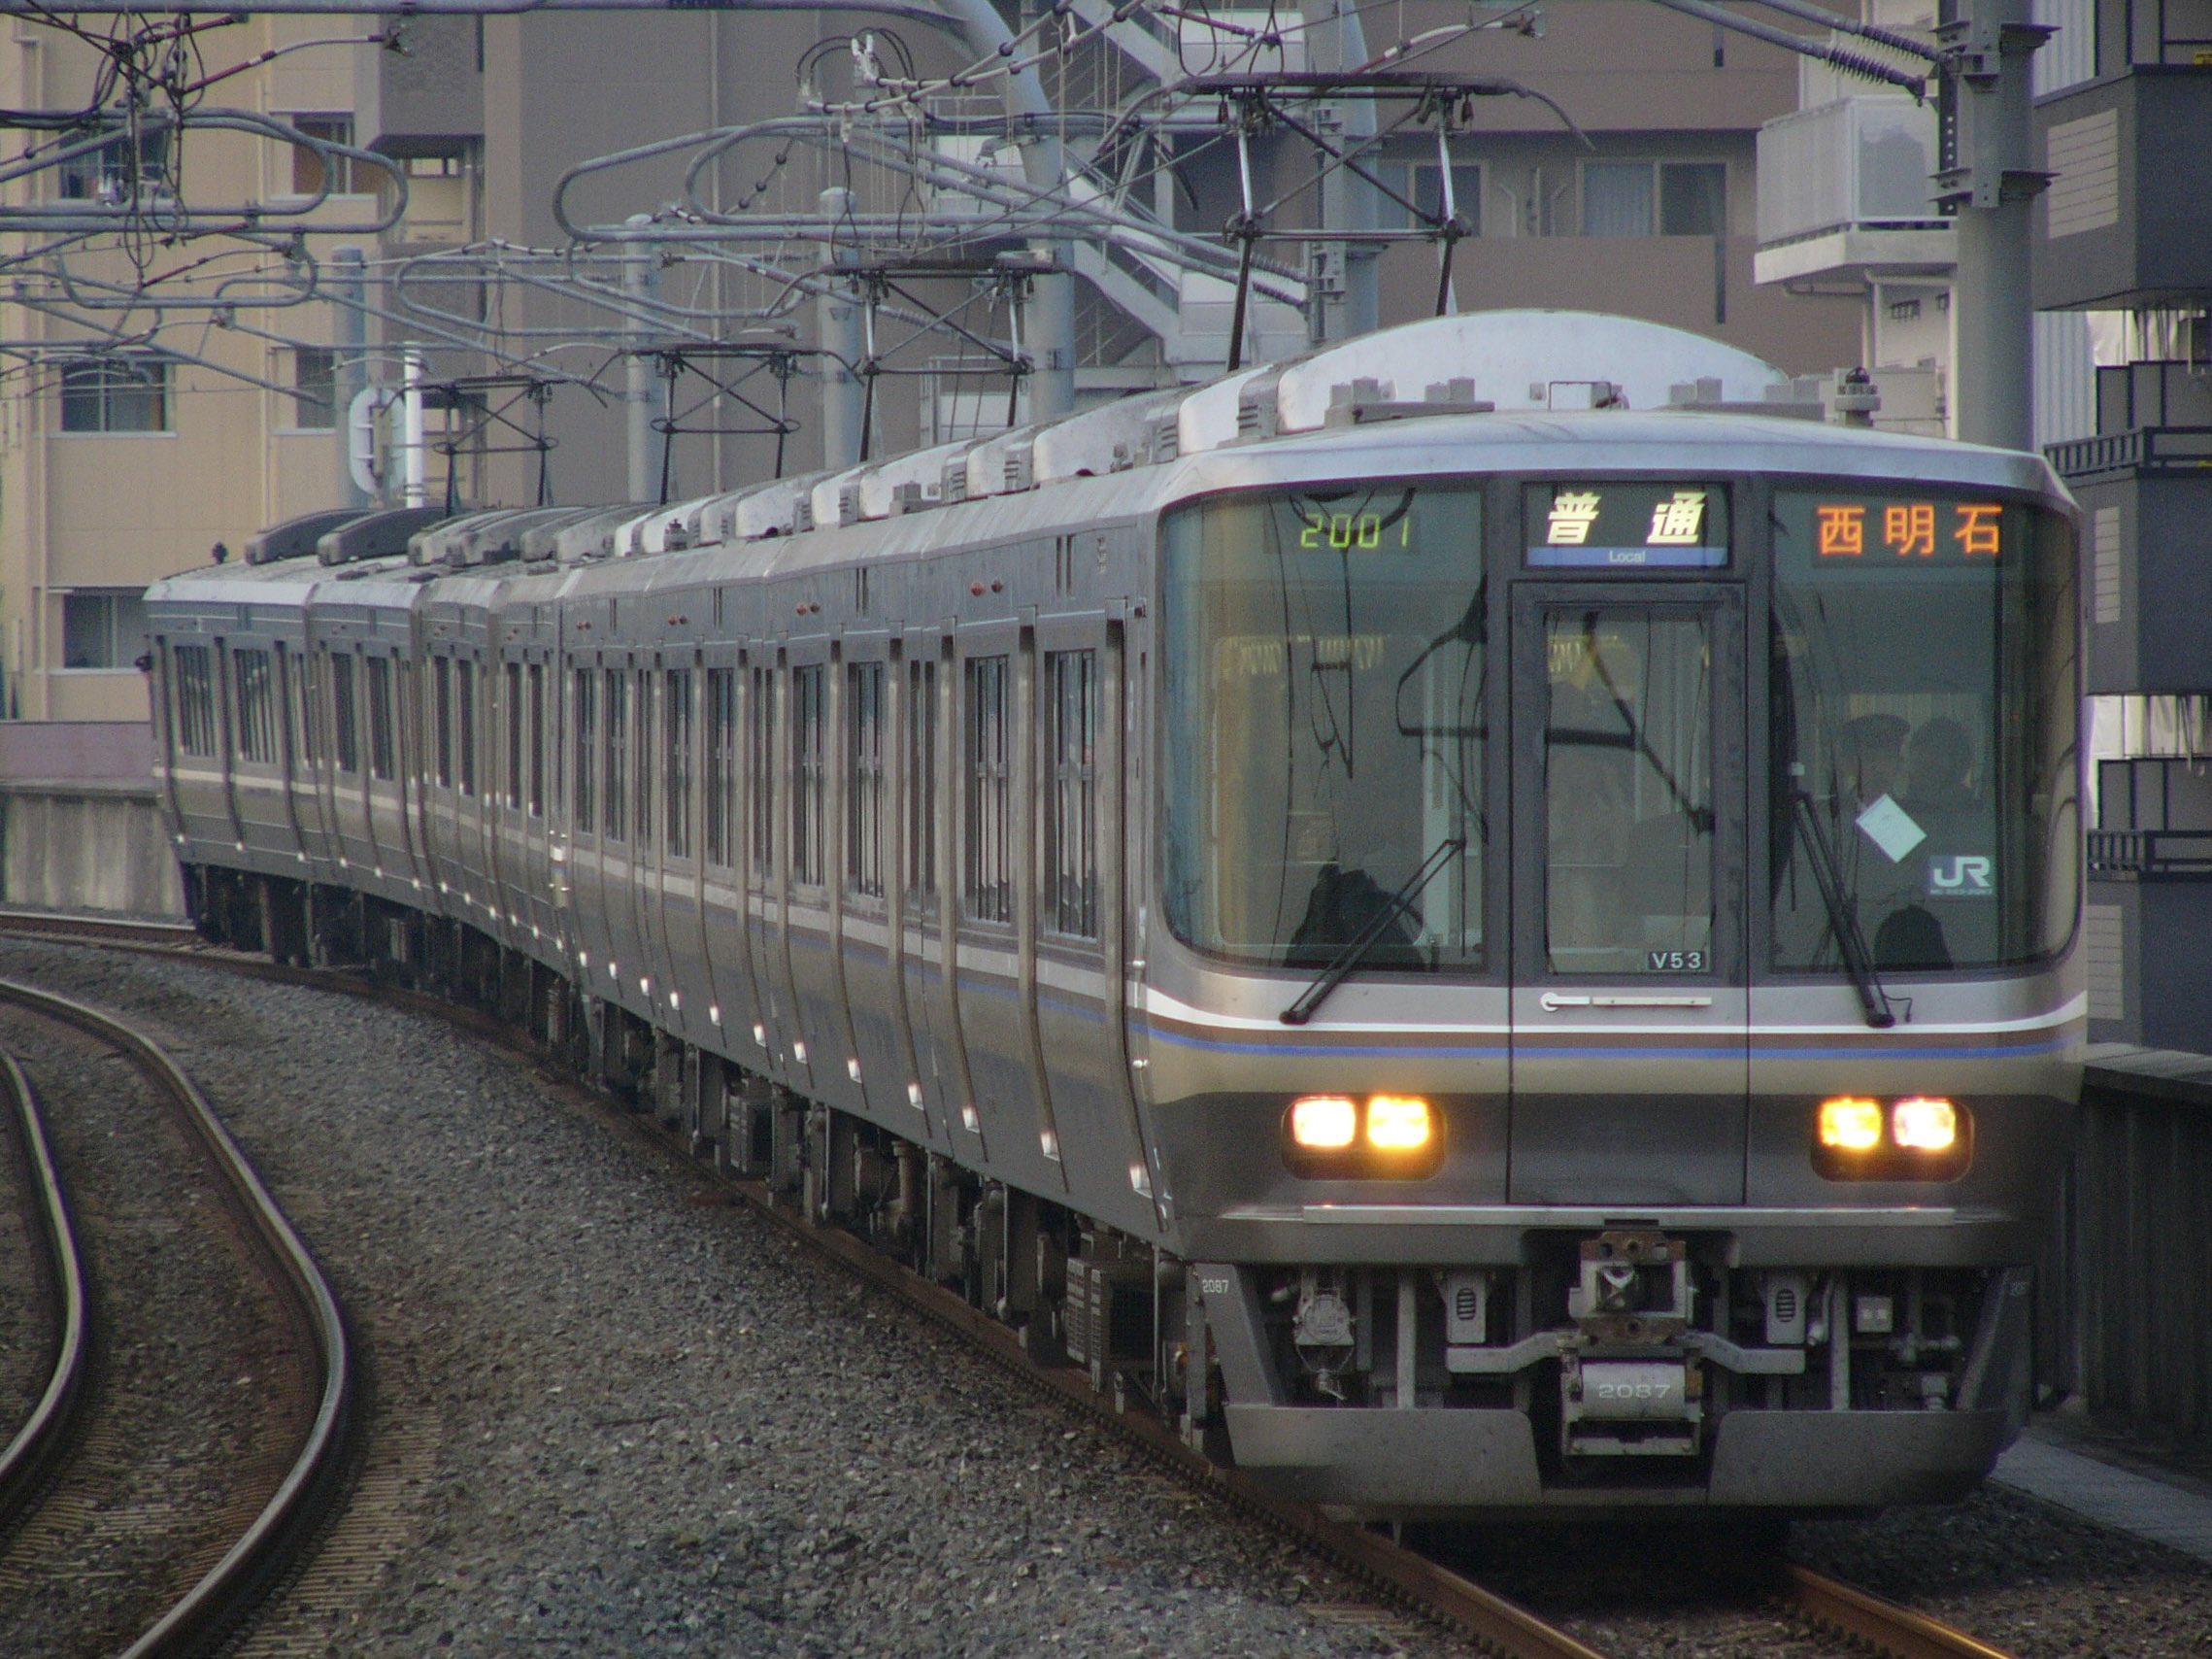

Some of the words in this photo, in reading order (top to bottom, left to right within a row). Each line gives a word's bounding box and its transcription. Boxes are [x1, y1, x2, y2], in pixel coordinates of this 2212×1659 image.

[1546, 491, 1708, 544] 普通
[1818, 503, 2003, 555] 西明石
[1609, 550, 1646, 563] Local
[1933, 856, 1991, 888] JR
[1652, 952, 1701, 969] V53
[1202, 1279, 1229, 1293] 2087
[1598, 1384, 1671, 1399] 2087
